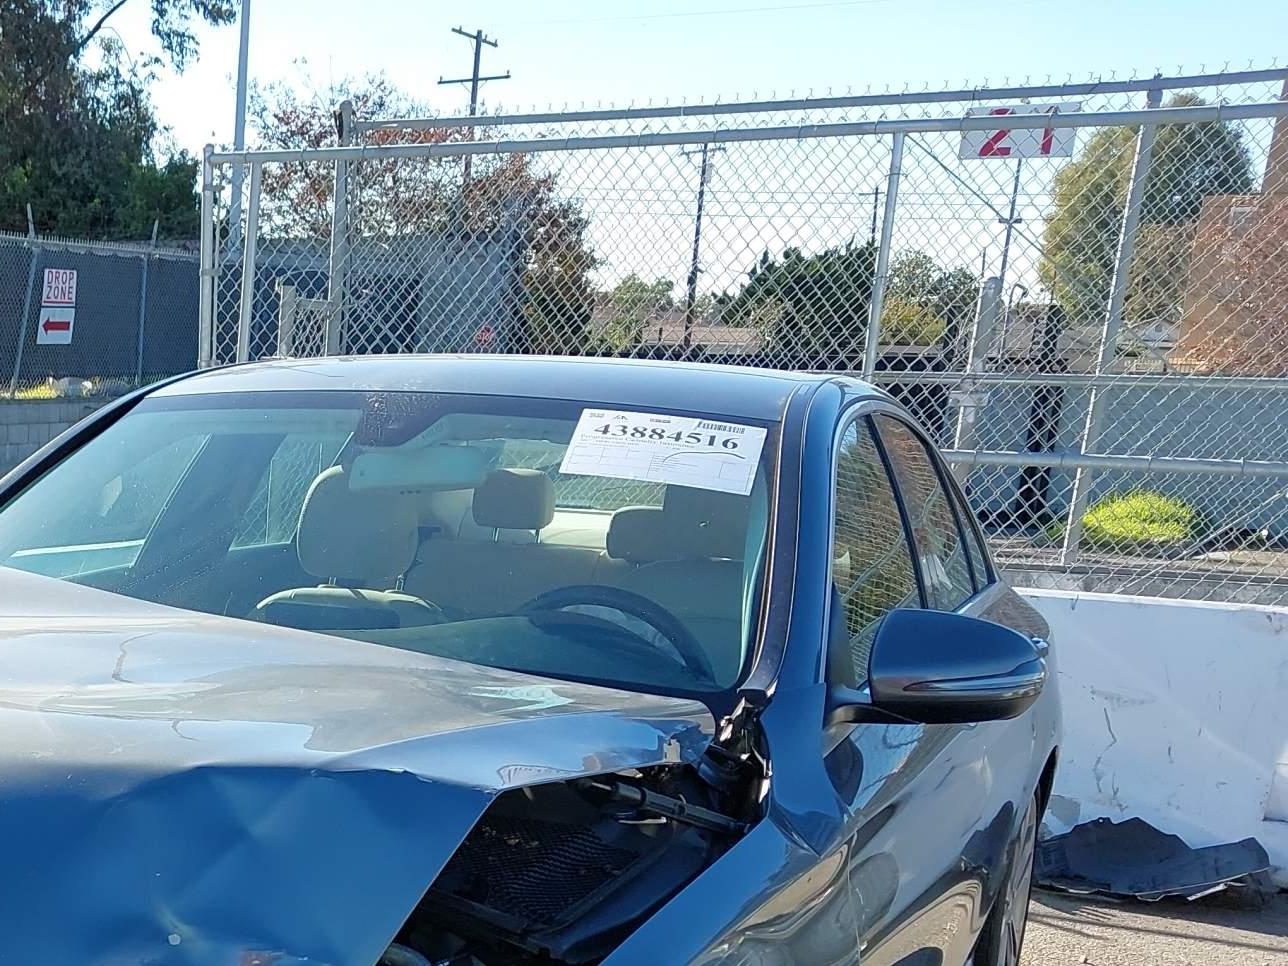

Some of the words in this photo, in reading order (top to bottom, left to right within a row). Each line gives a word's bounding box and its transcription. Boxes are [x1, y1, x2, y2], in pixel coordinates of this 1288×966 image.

[47, 270, 75, 286] DROP
[46, 285, 74, 300] ZONE
[593, 423, 739, 450] 43884516
